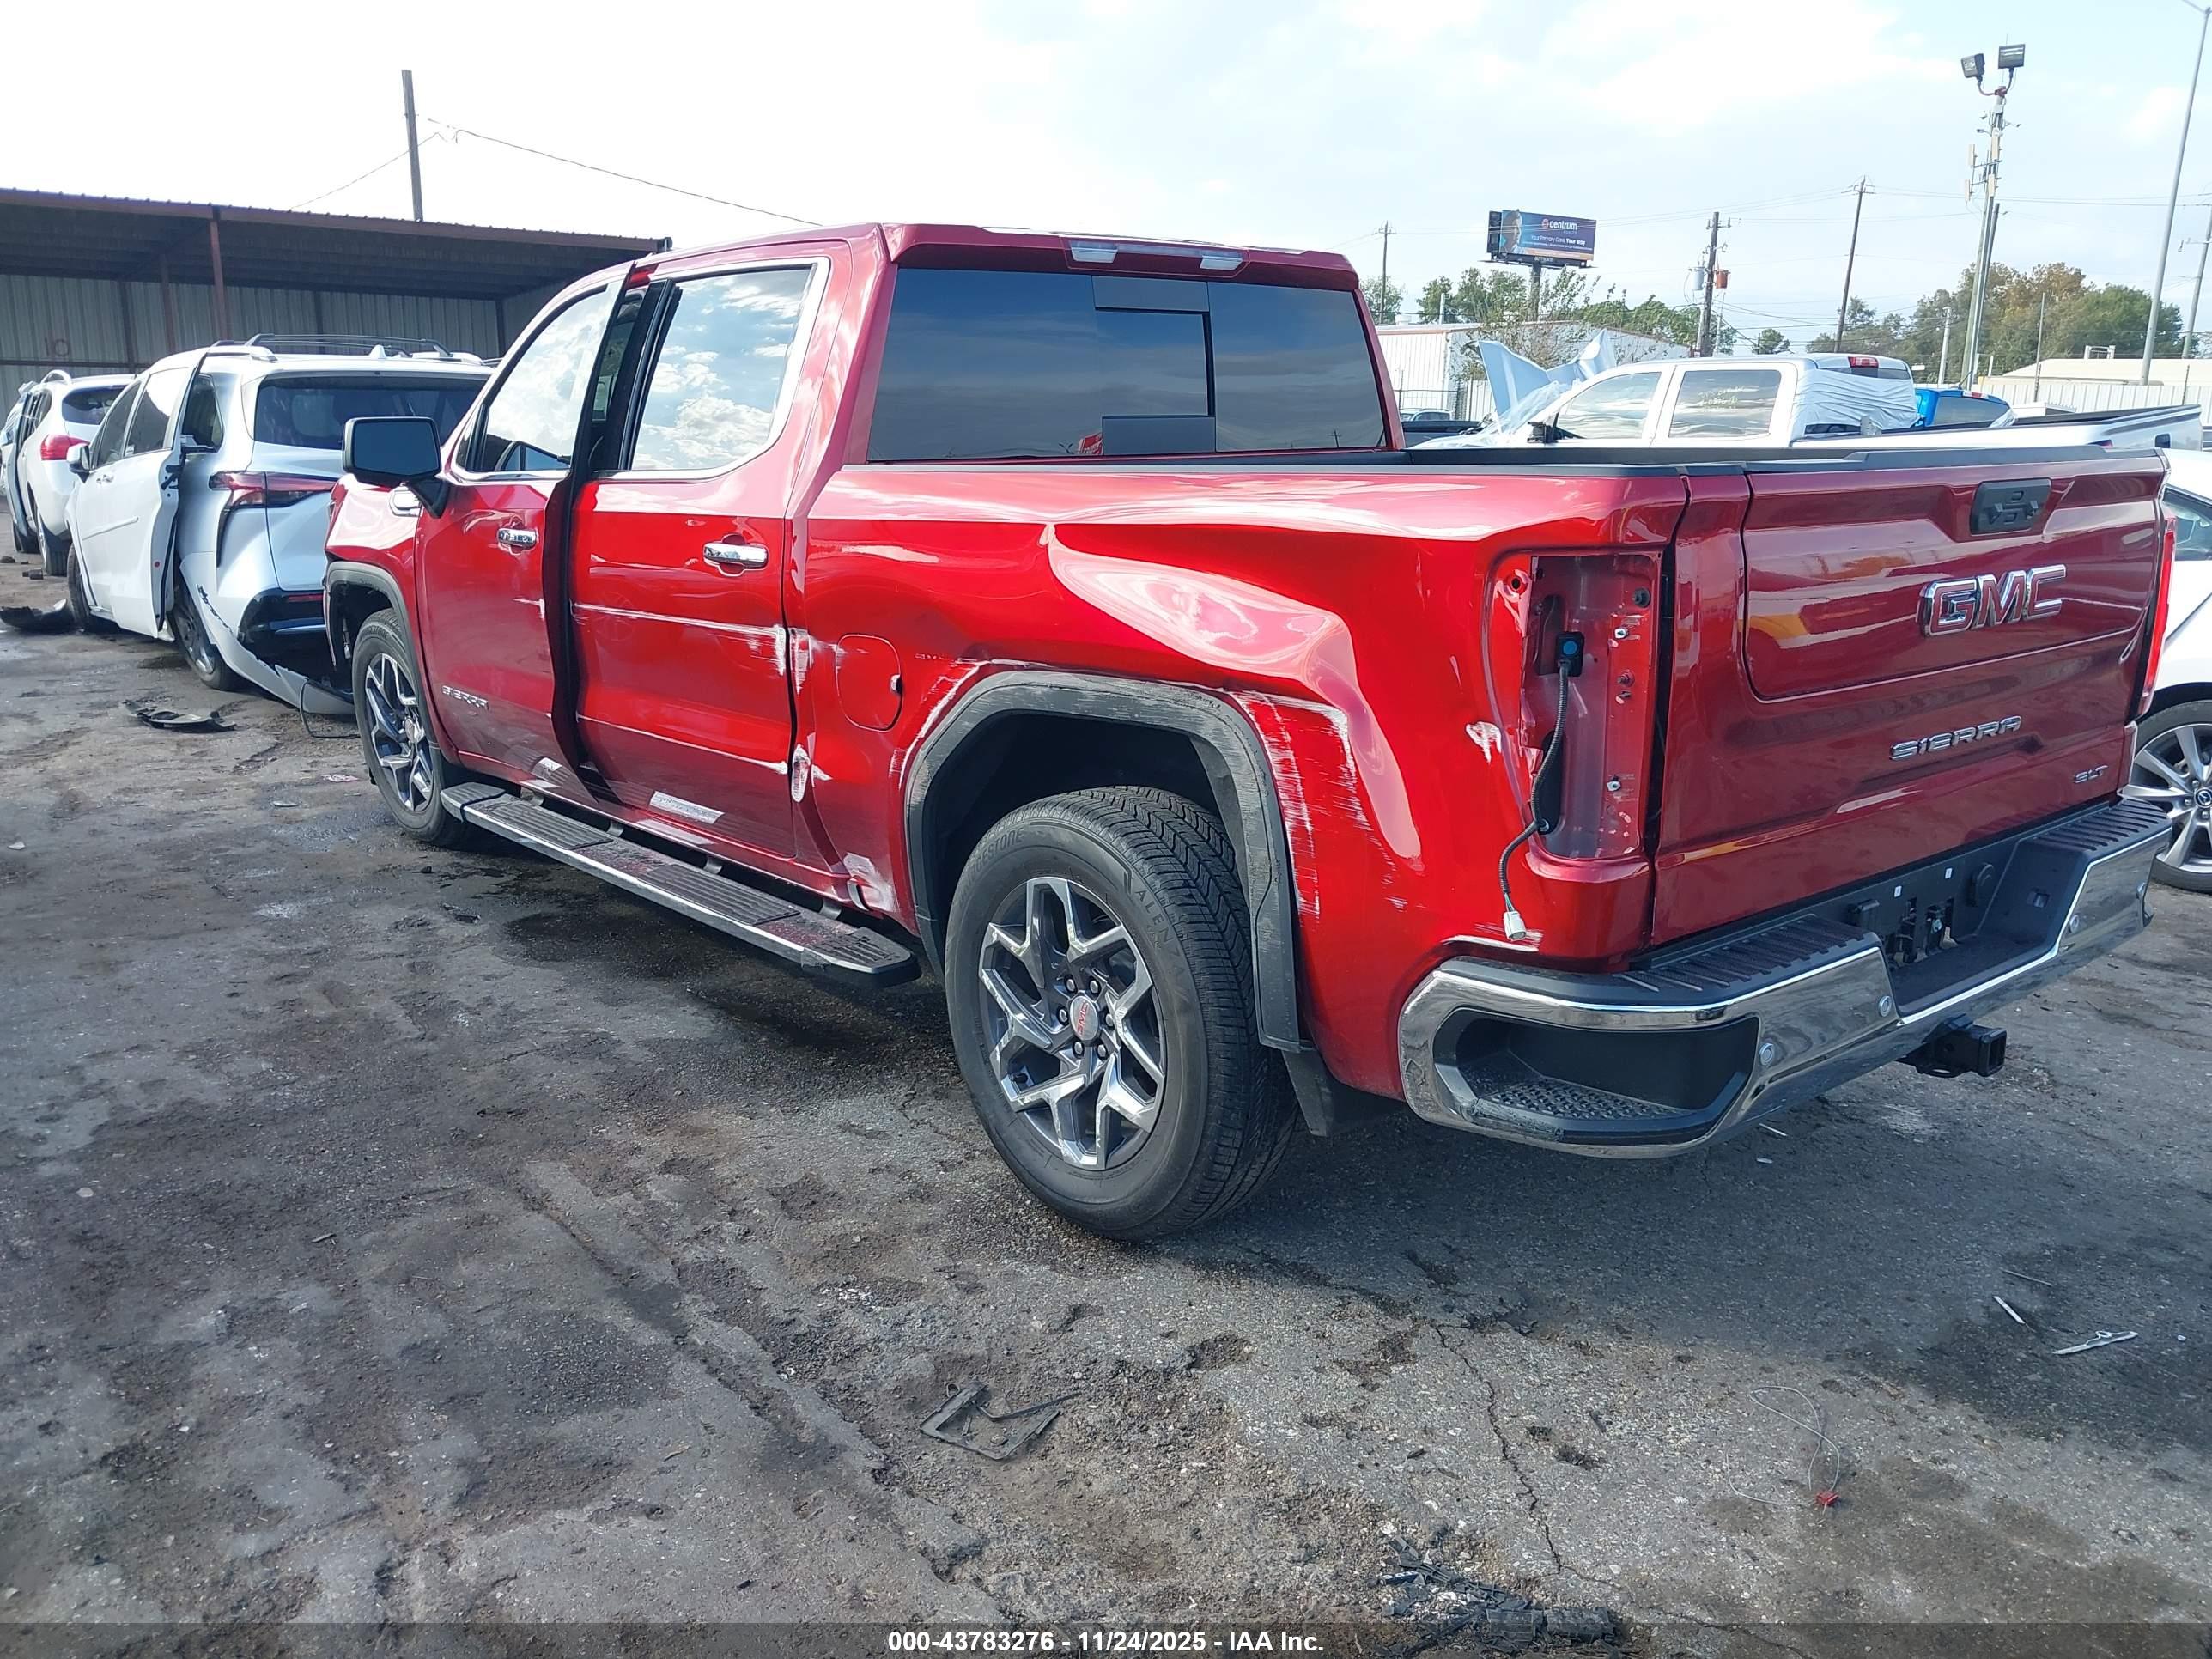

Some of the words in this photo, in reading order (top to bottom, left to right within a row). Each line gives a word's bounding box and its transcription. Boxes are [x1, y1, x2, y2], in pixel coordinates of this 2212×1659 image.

[1549, 220, 1577, 230] centrum
[1917, 562, 2067, 639] GMC
[1889, 714, 2022, 761] SIERRA
[2074, 764, 2108, 785] SLT
[957, 827, 1025, 908] IDGESTONE
[1074, 999, 1090, 1037] GMC
